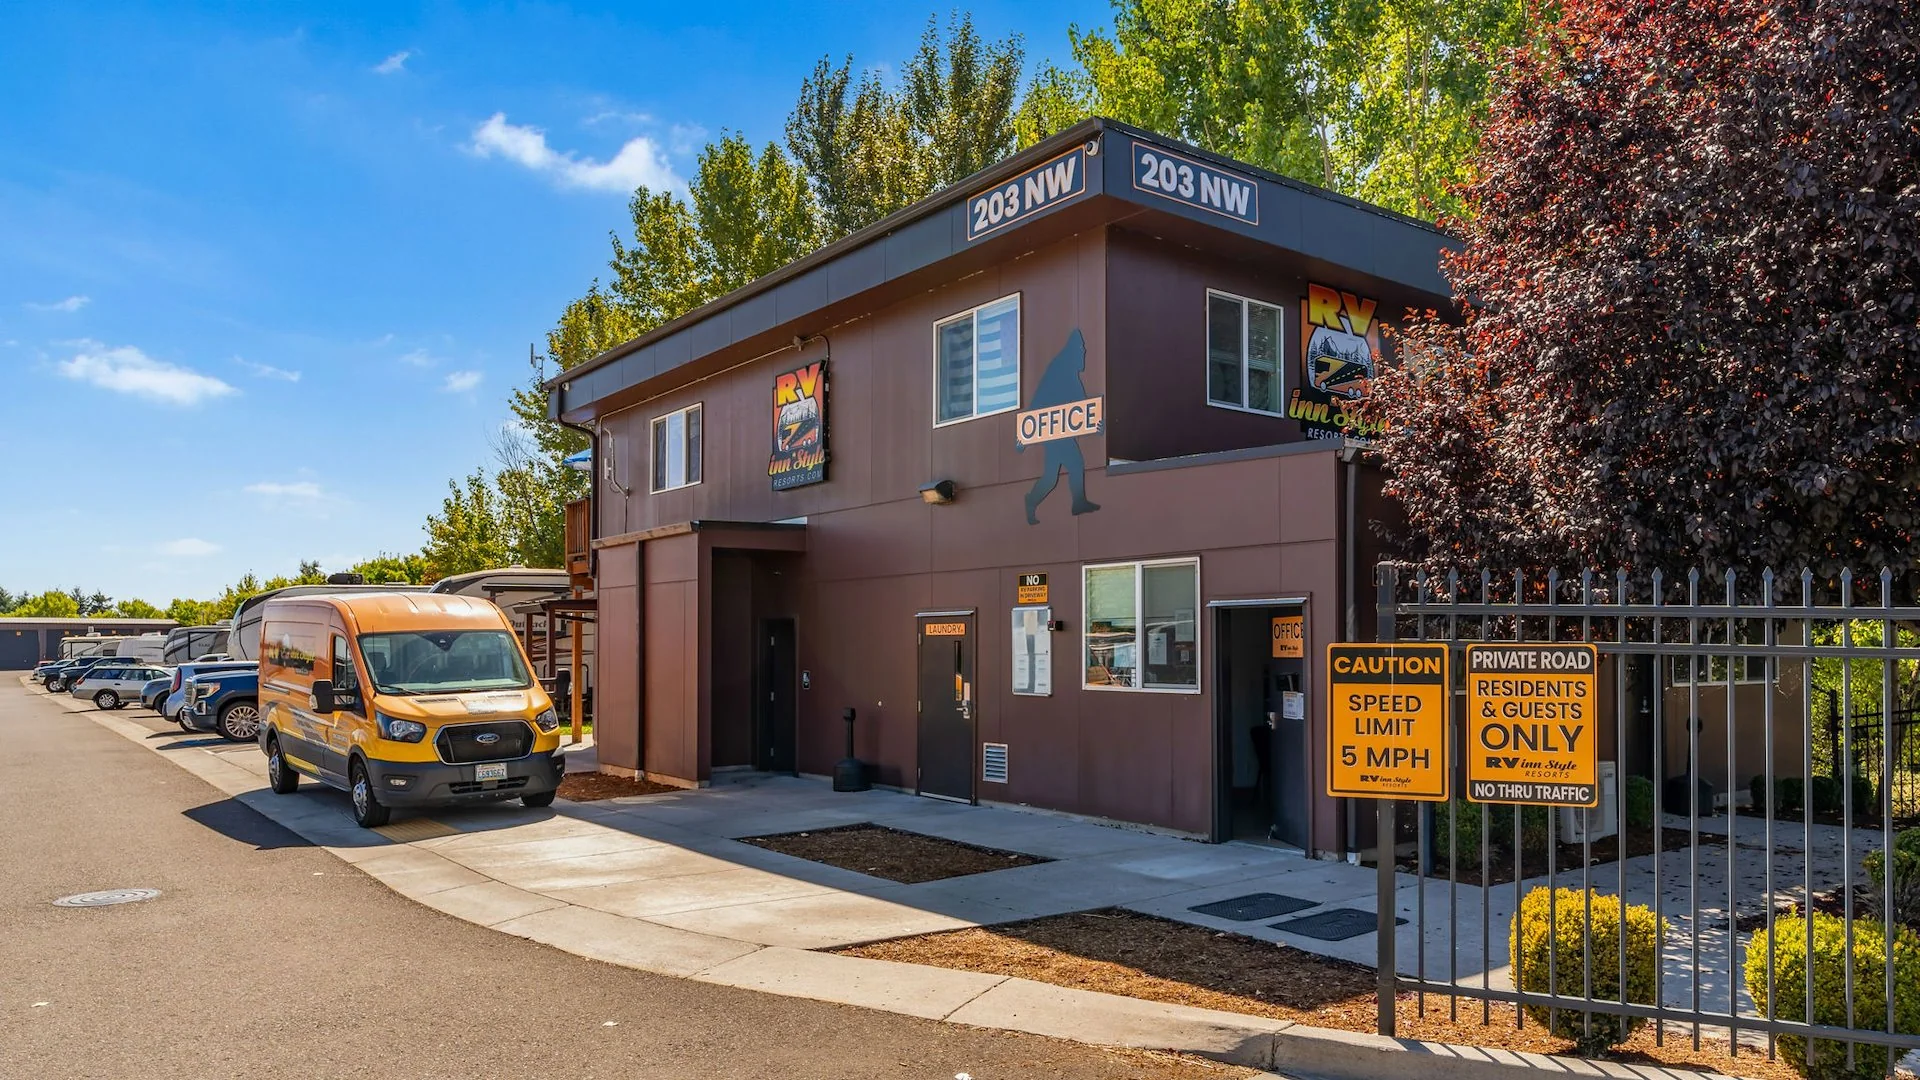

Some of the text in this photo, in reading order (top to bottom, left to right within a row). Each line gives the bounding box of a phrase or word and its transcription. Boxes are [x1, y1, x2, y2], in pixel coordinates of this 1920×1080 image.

[1141, 153, 1250, 216] 203 NW
[973, 157, 1076, 232] 203 NW
[1309, 283, 1377, 336] RV
[777, 363, 820, 406] RV
[1289, 388, 1331, 424] inn
[1021, 402, 1096, 439] OFFICE
[768, 445, 825, 476] inn Style
[1026, 575, 1039, 586] NO
[929, 624, 961, 634] LAUNDRY
[1335, 656, 1440, 674] CAUTION
[1472, 651, 1591, 670] PRIVATE ROAD
[1477, 680, 1587, 699] RESIDENTS
[1348, 694, 1422, 712] SPEED
[1481, 701, 1583, 720] & GUESTS
[1356, 718, 1415, 736] LIMIT
[1479, 723, 1584, 753] ONLY
[1341, 745, 1430, 770] 5 MPH
[1485, 756, 1578, 772] RV inn Style
[1393, 776, 1412, 784] Style
[1524, 770, 1571, 779] RESORTS
[1474, 783, 1590, 801] NO THRU TRAFFIC
